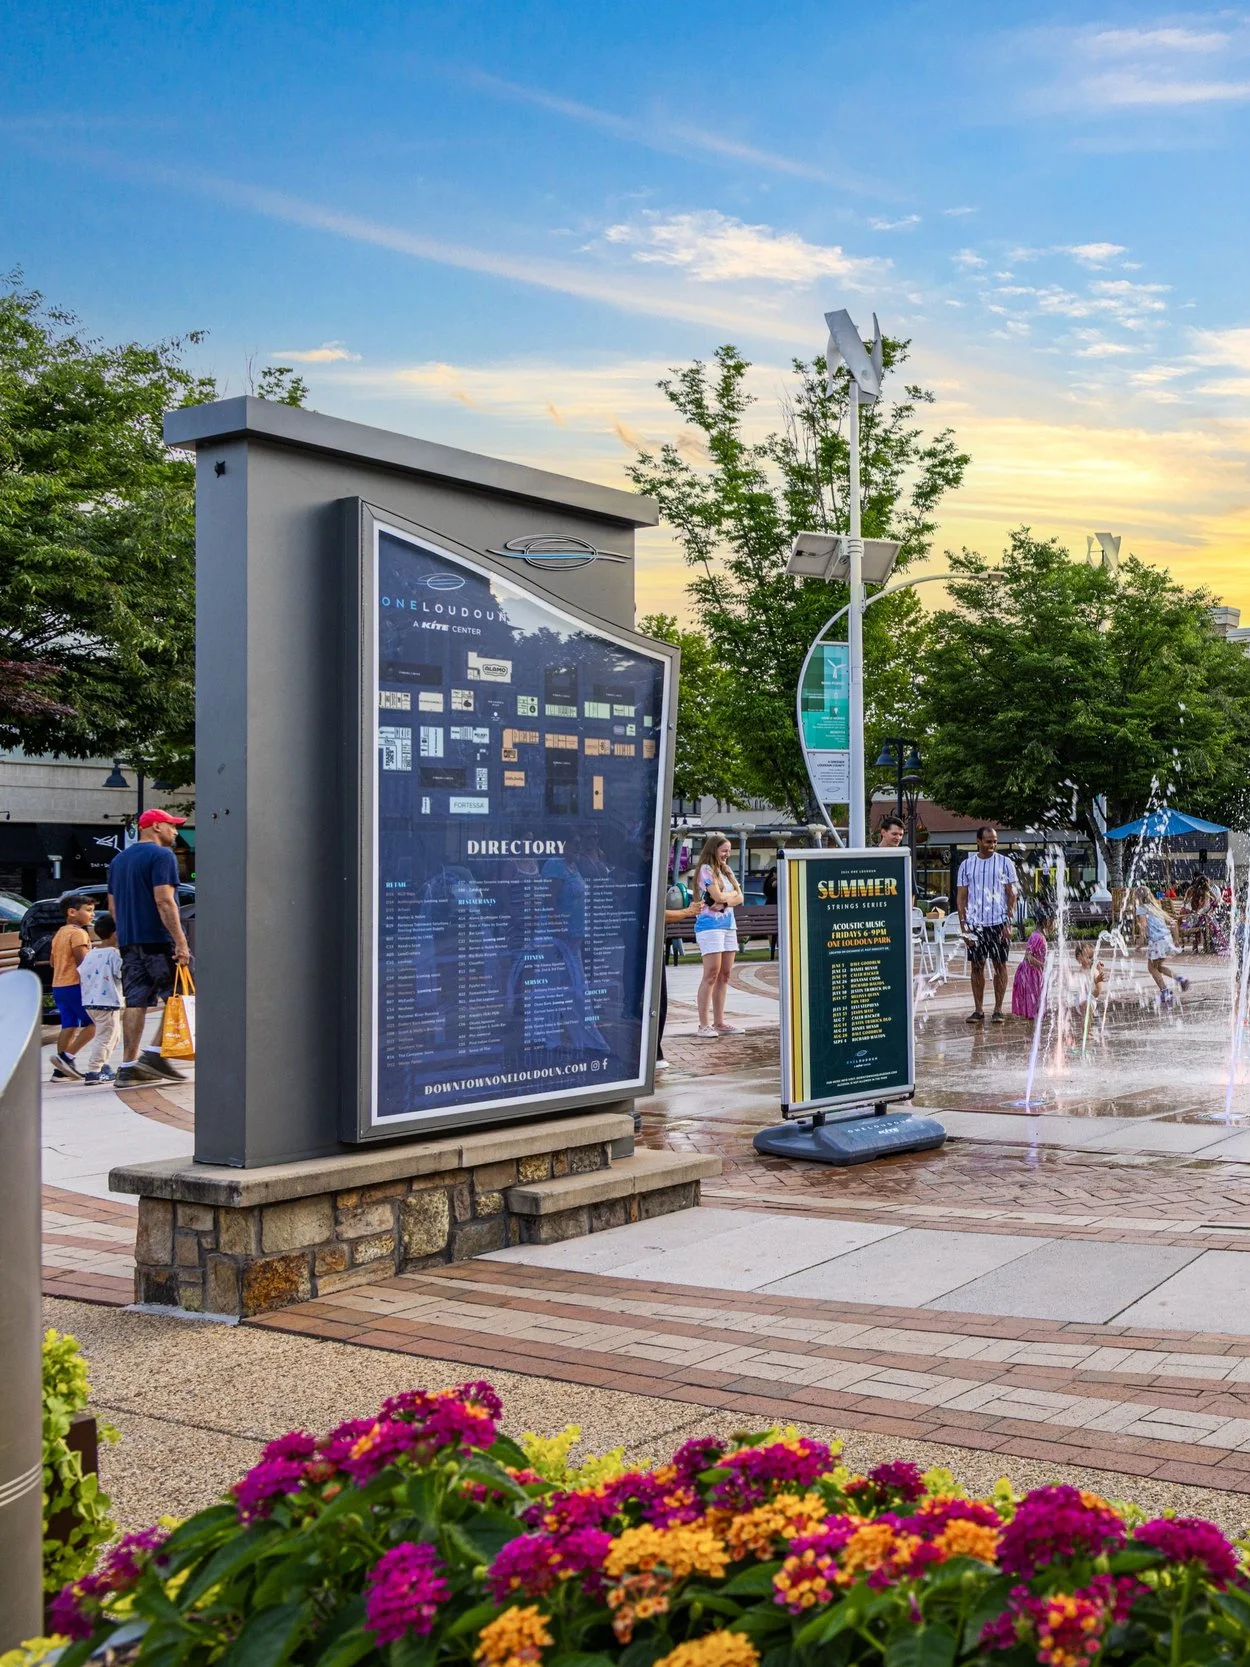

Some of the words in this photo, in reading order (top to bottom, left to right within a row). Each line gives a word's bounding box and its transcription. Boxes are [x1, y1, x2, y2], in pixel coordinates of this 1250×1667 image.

[421, 620, 449, 631] KITE
[452, 625, 481, 635] CENTER
[467, 840, 566, 854] DIRECTORY
[817, 877, 898, 899] SUMMER
[832, 922, 864, 930] ACOUSTIC
[865, 920, 886, 928] MUSIC
[831, 930, 861, 939] FRIDAYS
[827, 940, 841, 948] ONE
[842, 938, 873, 947] LOUDOUN
[874, 936, 891, 944] PARK
[424, 1063, 587, 1095] DOWNTOWNONELOUDOUN.COM
